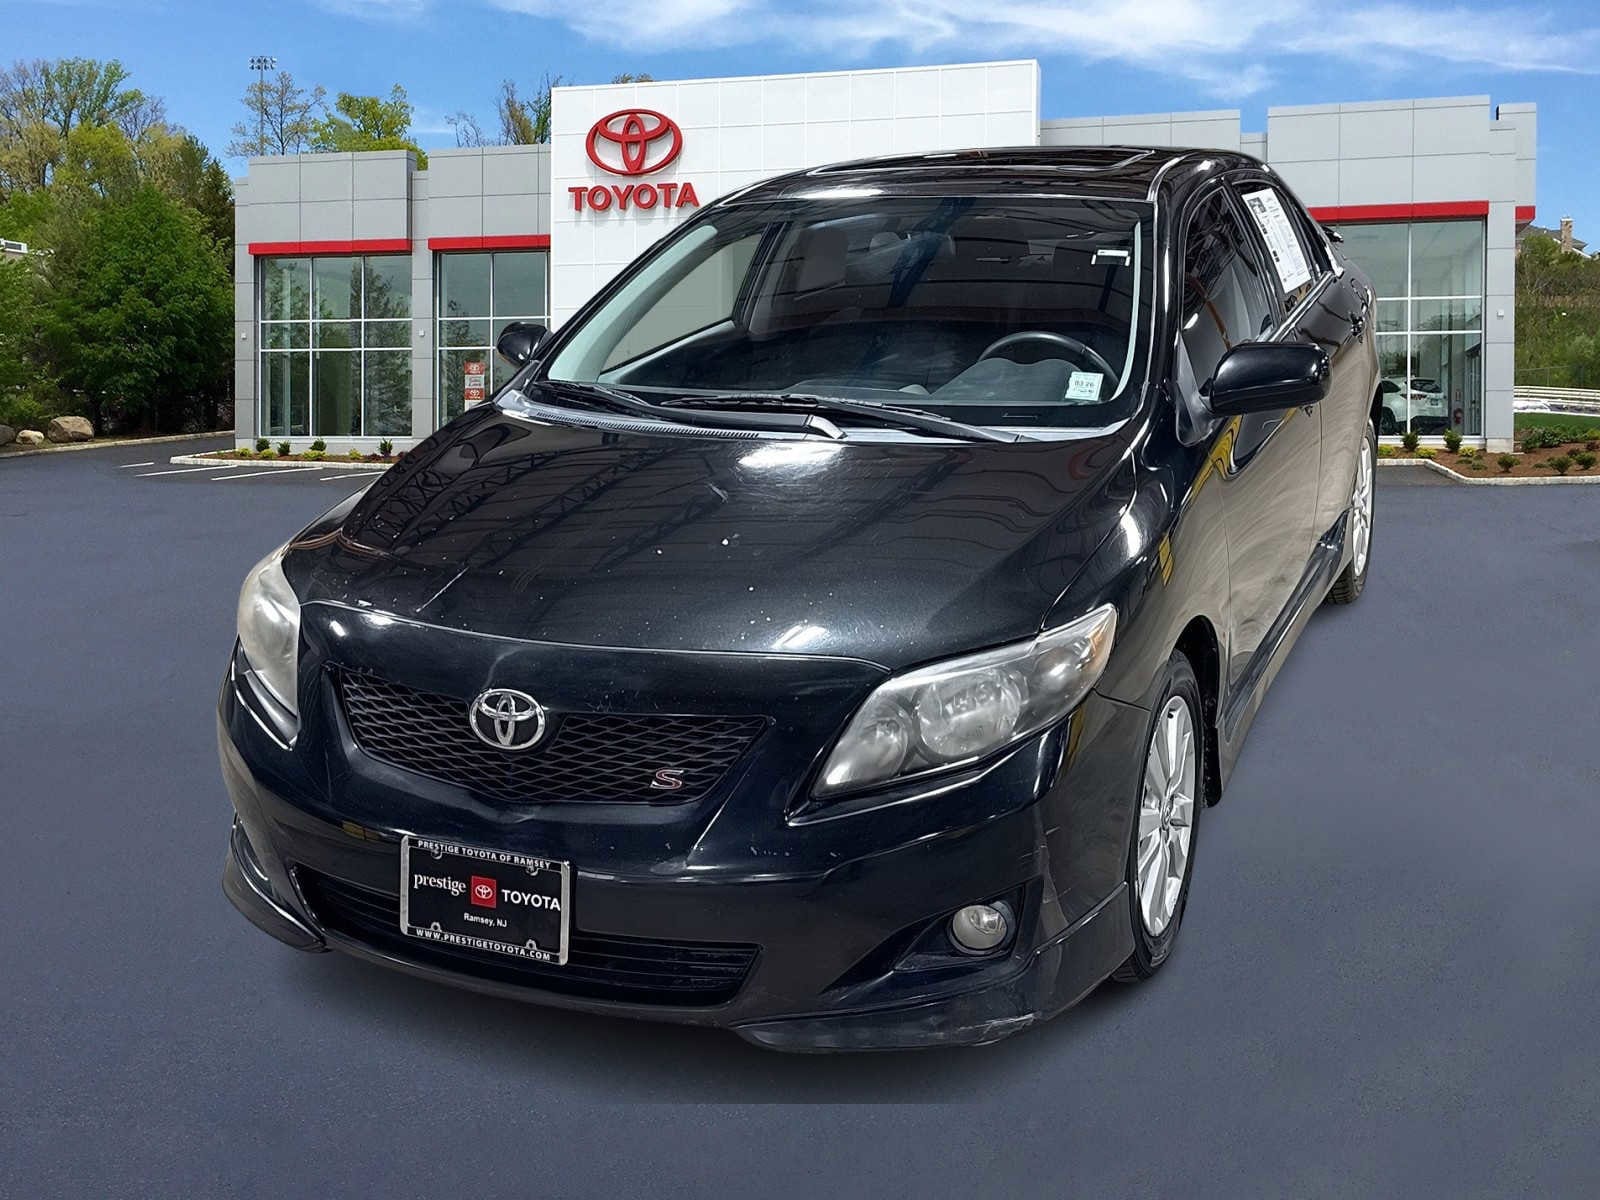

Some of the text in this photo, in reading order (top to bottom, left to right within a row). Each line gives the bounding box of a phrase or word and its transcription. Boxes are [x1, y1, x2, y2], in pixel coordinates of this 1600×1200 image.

[568, 182, 700, 212] TOYOTA
[418, 840, 551, 869] PRESTIGE TOYOTA OF RAMSEY
[413, 873, 467, 897] prestige
[501, 888, 561, 912] TOYOTA
[463, 912, 508, 928] Ramsey, NJ
[416, 928, 551, 961] WWW.PRESTIGETOYOTA.COM
